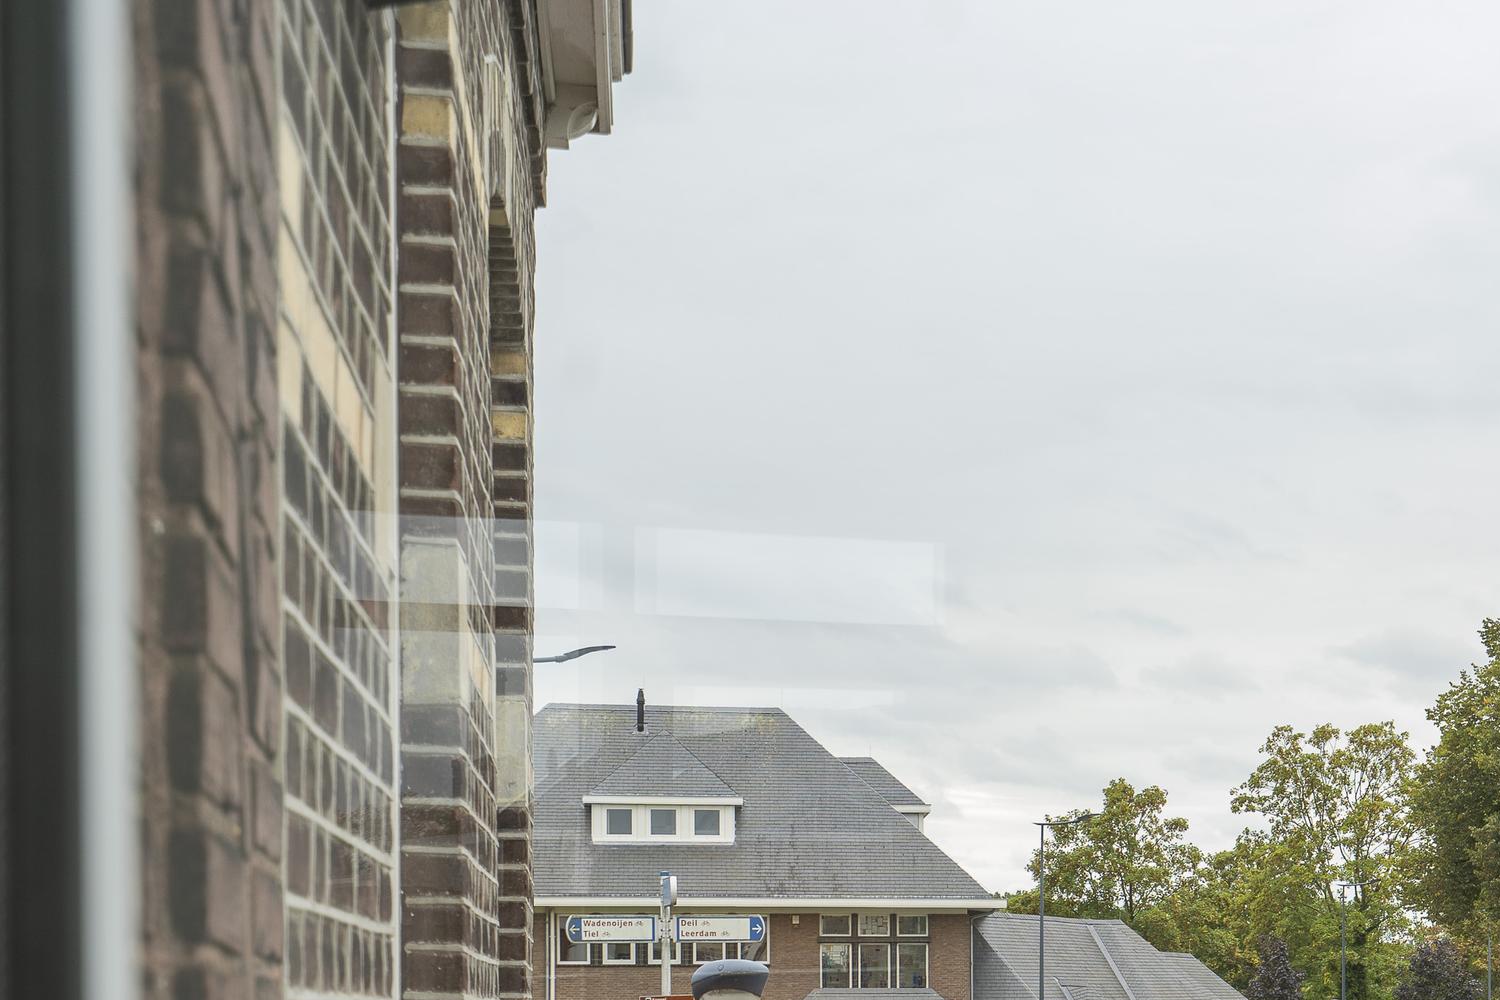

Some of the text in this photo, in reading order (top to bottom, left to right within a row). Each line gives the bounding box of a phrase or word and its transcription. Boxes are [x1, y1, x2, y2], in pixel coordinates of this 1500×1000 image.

[583, 919, 633, 929] Wadenoijen
[681, 919, 698, 927] Deil
[583, 930, 599, 938] Tiel
